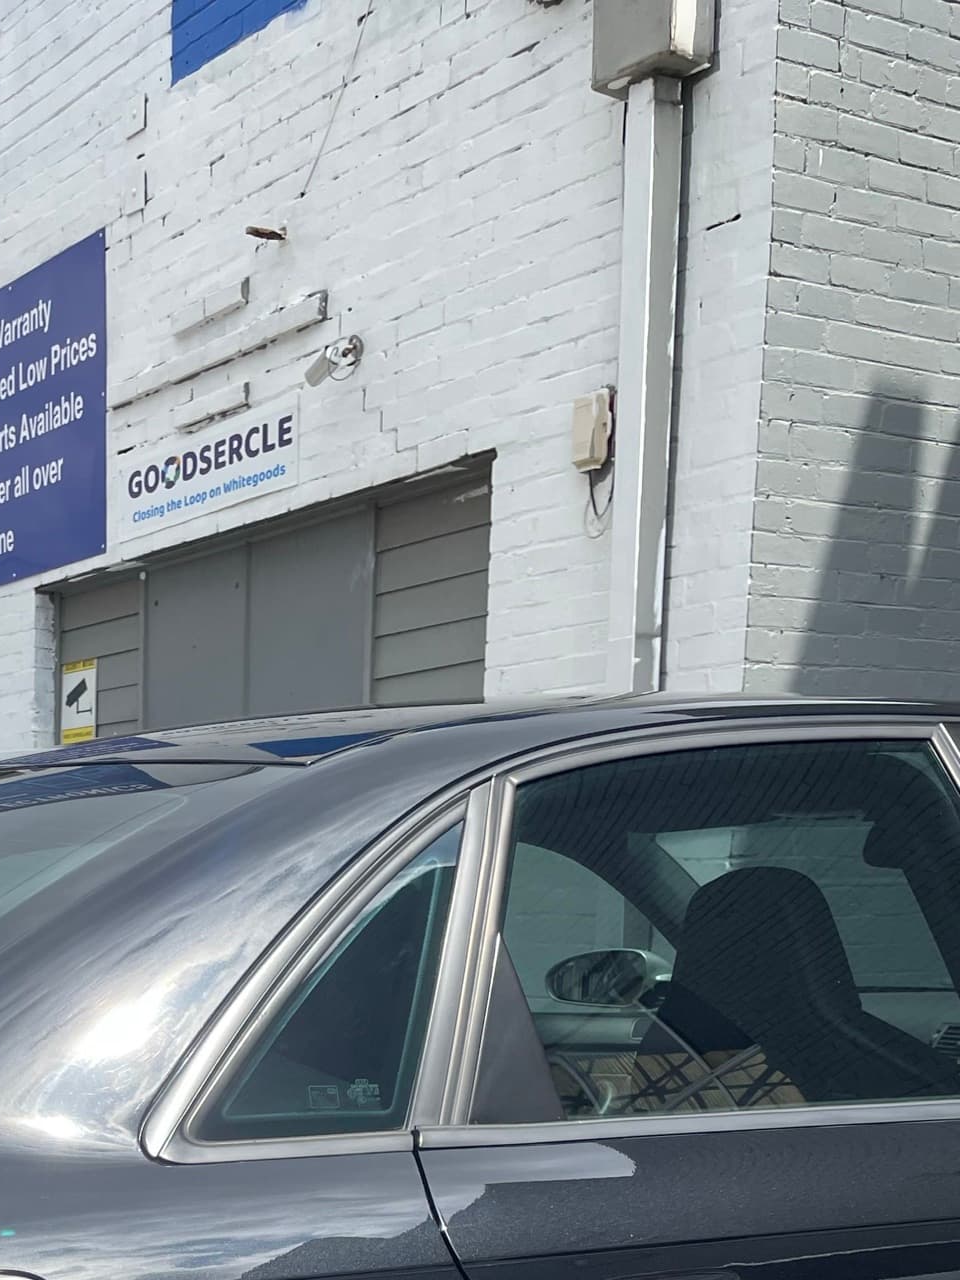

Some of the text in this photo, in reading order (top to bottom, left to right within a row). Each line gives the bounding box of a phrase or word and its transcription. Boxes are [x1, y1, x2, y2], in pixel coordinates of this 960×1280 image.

[19, 354, 47, 388] Low
[50, 333, 97, 376] Prices
[19, 394, 83, 443] Available
[13, 471, 30, 499] all
[32, 458, 64, 491] over
[128, 415, 293, 499] GOODSERCLE
[132, 464, 286, 523] Closing the Loop on Whitegoods
